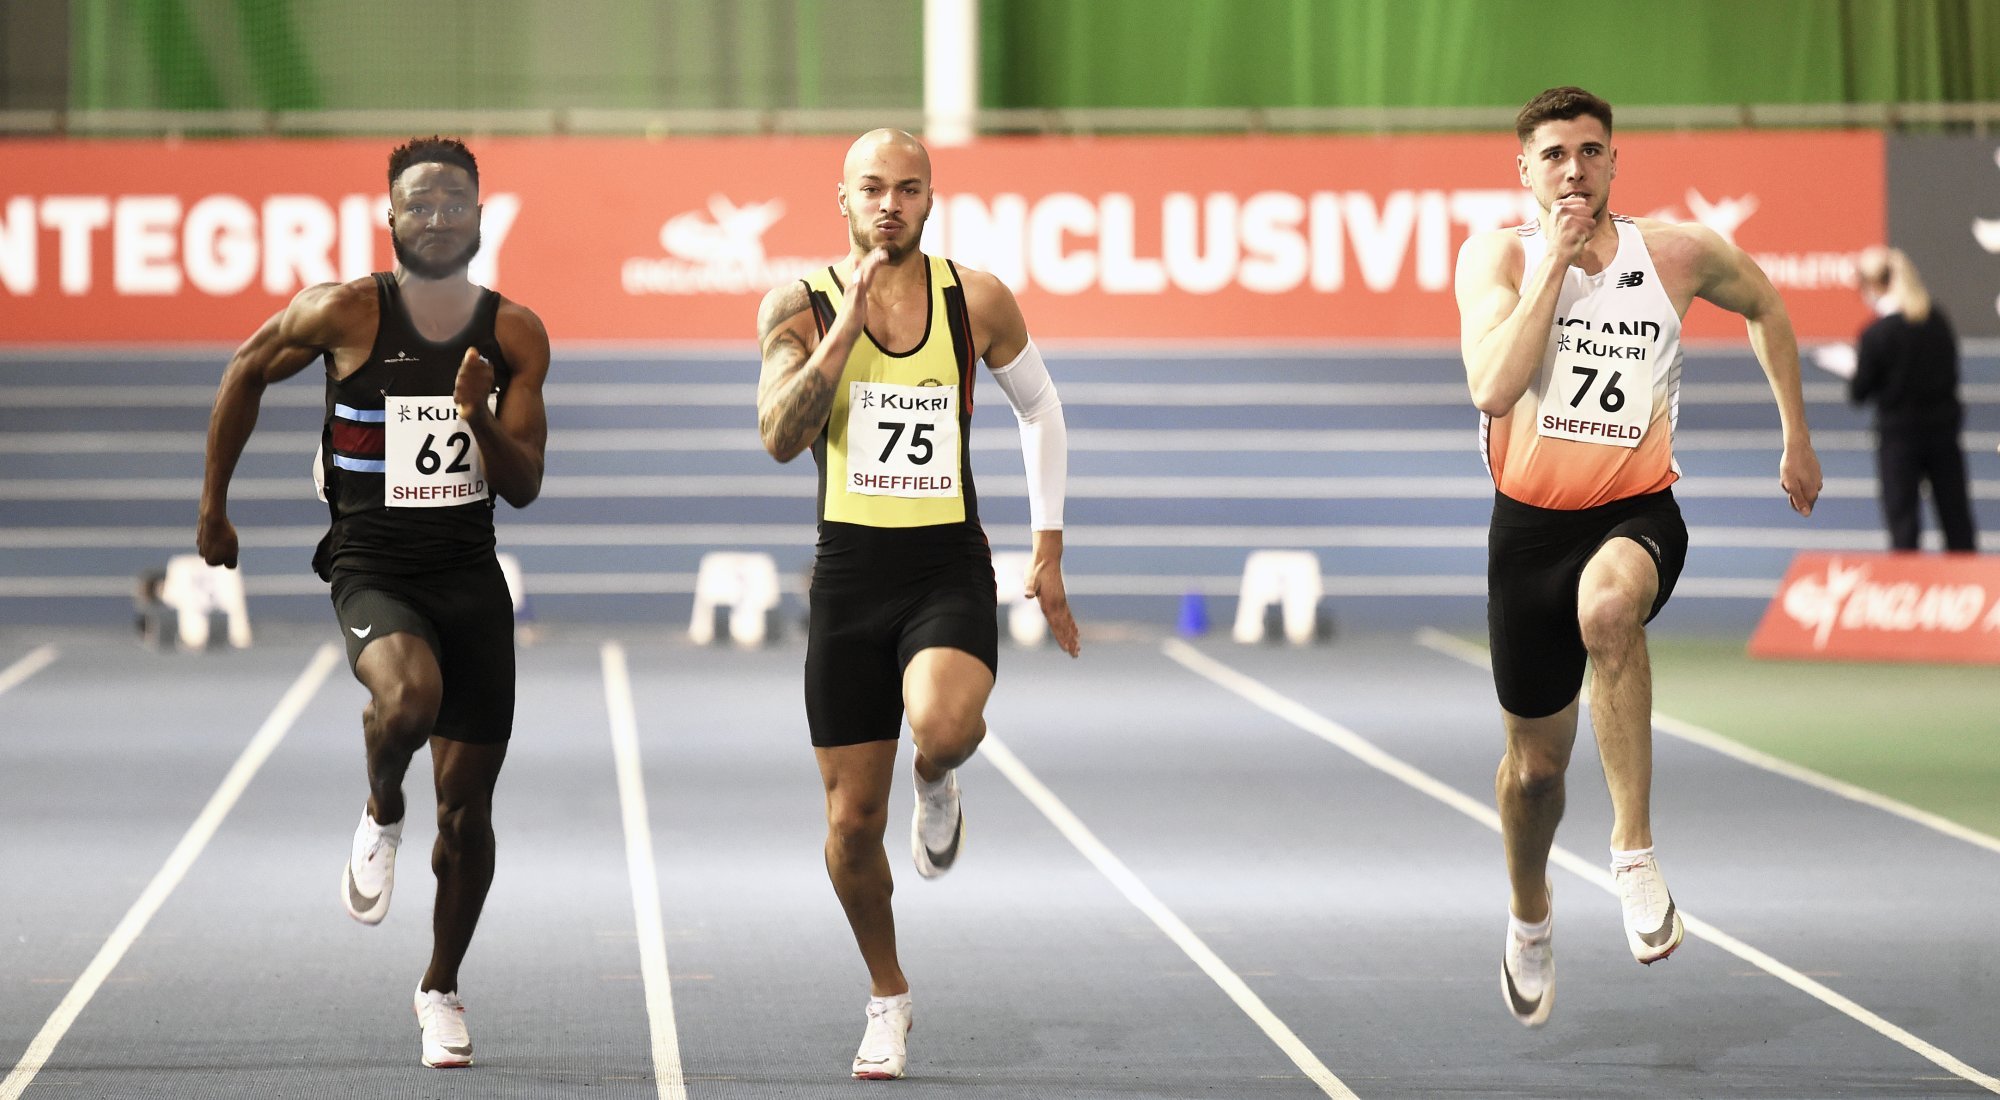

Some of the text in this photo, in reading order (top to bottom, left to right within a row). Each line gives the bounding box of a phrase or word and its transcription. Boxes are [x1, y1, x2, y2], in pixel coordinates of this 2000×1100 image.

[1576, 338, 1646, 361] KUKRI
[1570, 366, 1625, 413] 76
[881, 393, 948, 411] KUKRI
[1543, 415, 1642, 440] SHEFFIELD
[415, 431, 471, 475] 62
[878, 422, 934, 466] 75
[393, 480, 484, 500] SHEFFIELD
[853, 472, 952, 490] SHEFFIELD
